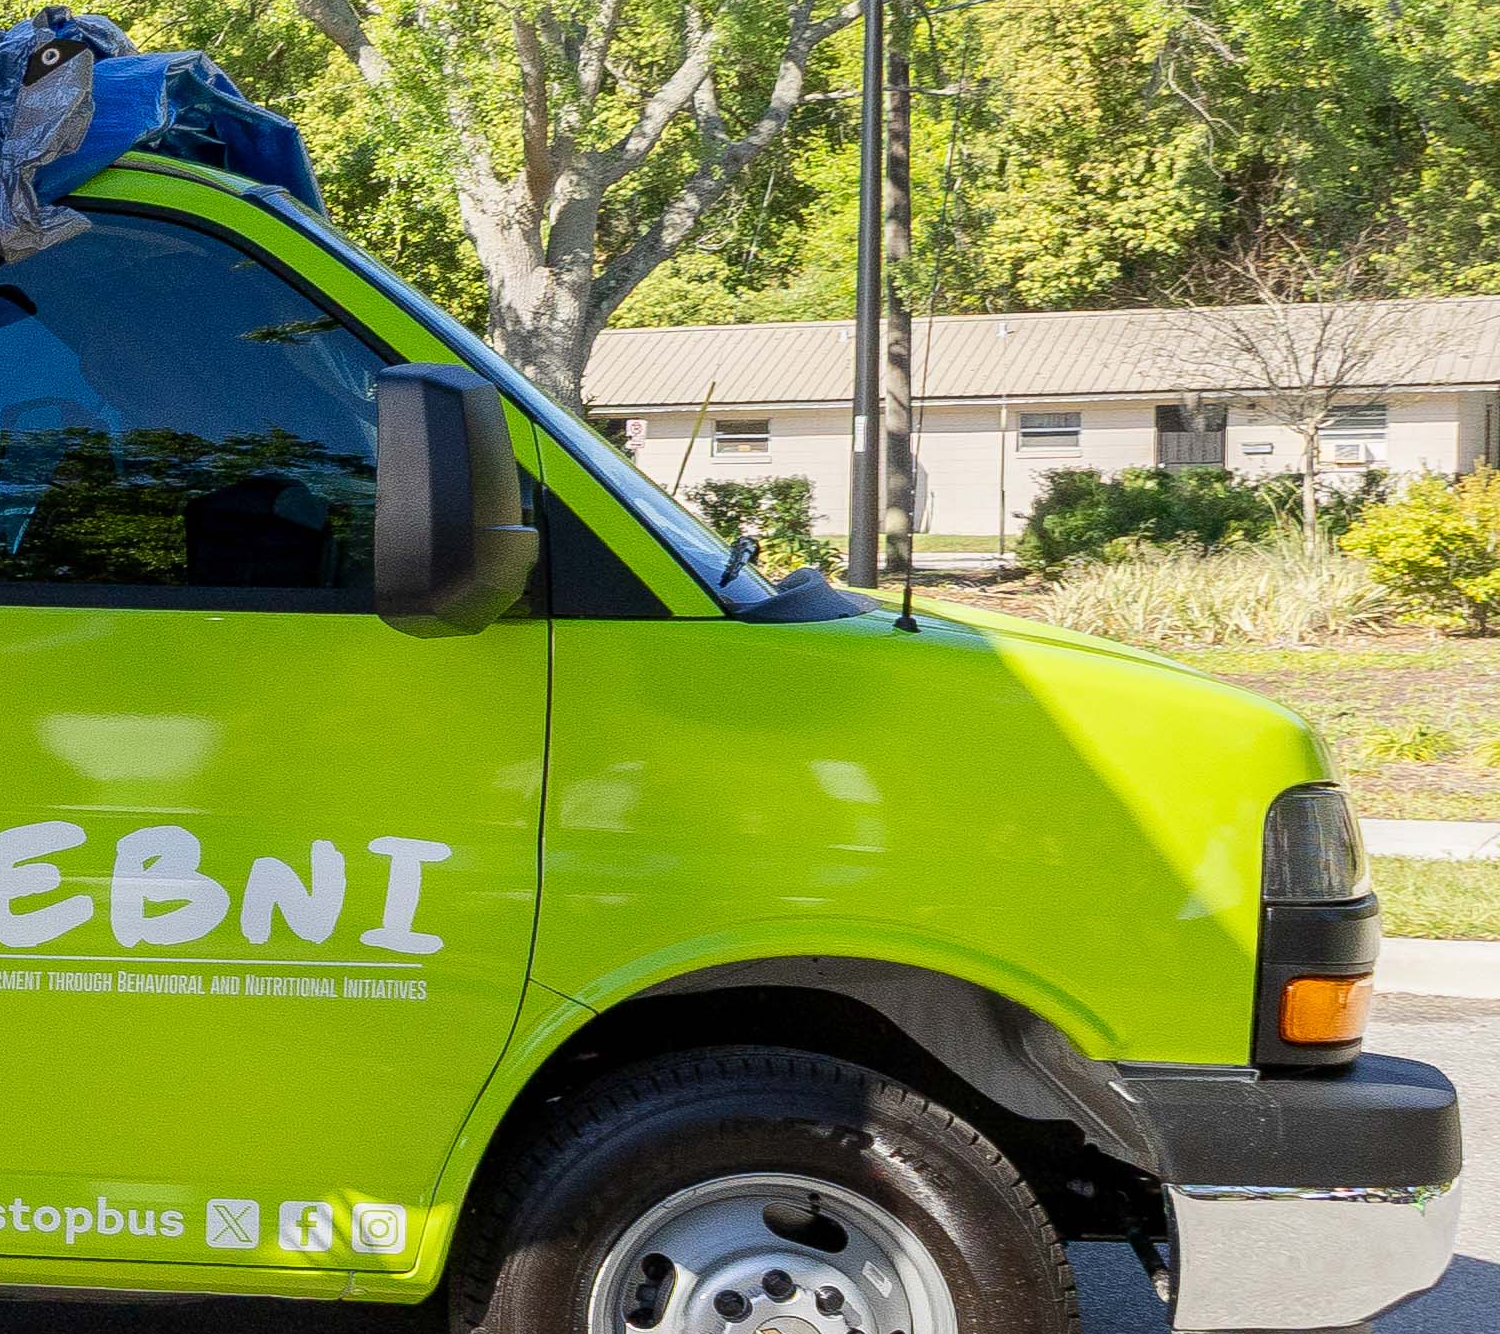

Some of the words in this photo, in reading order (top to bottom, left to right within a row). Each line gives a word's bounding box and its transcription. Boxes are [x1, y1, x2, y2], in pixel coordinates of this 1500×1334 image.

[48, 971, 113, 992] THROUGH
[117, 970, 205, 995] BEHAVIORAL
[210, 975, 240, 996] AND
[245, 974, 337, 998] NUTRITIONAL
[343, 976, 427, 1001] INITIATIVES
